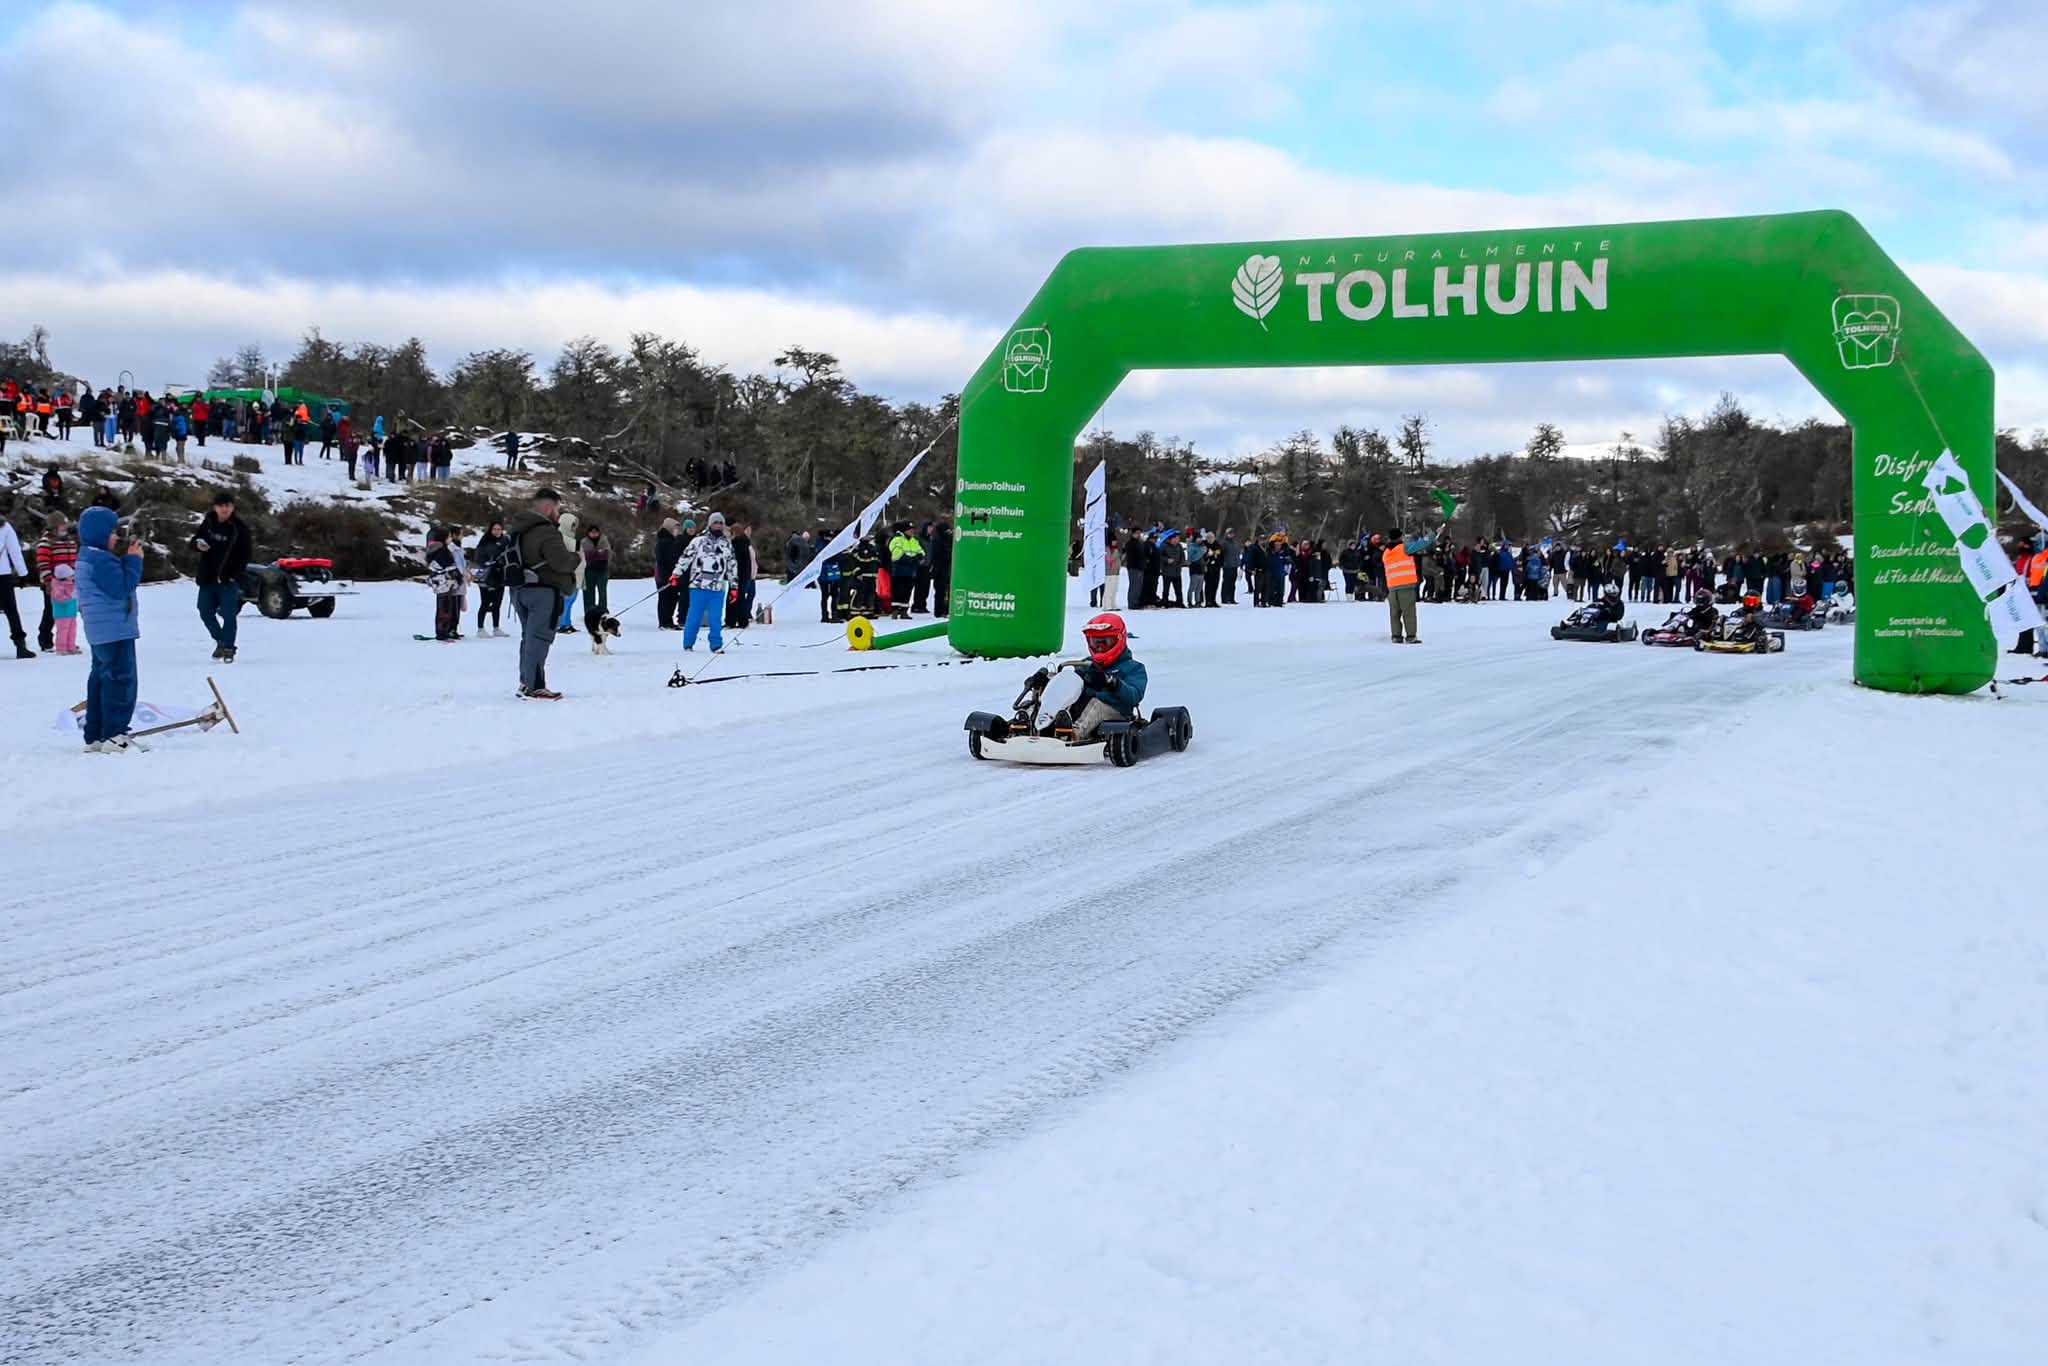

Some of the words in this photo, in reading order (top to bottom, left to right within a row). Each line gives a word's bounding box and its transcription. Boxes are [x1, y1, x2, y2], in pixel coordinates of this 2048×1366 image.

[1299, 240, 1612, 265] NATURALMENTE
[1295, 258, 1609, 322] TOLHUIN
[1874, 450, 1960, 482] Disfr
[1890, 568, 1907, 583] Fin
[1927, 567, 1965, 584] Mundo
[967, 599, 1016, 611] TOLHUIN
